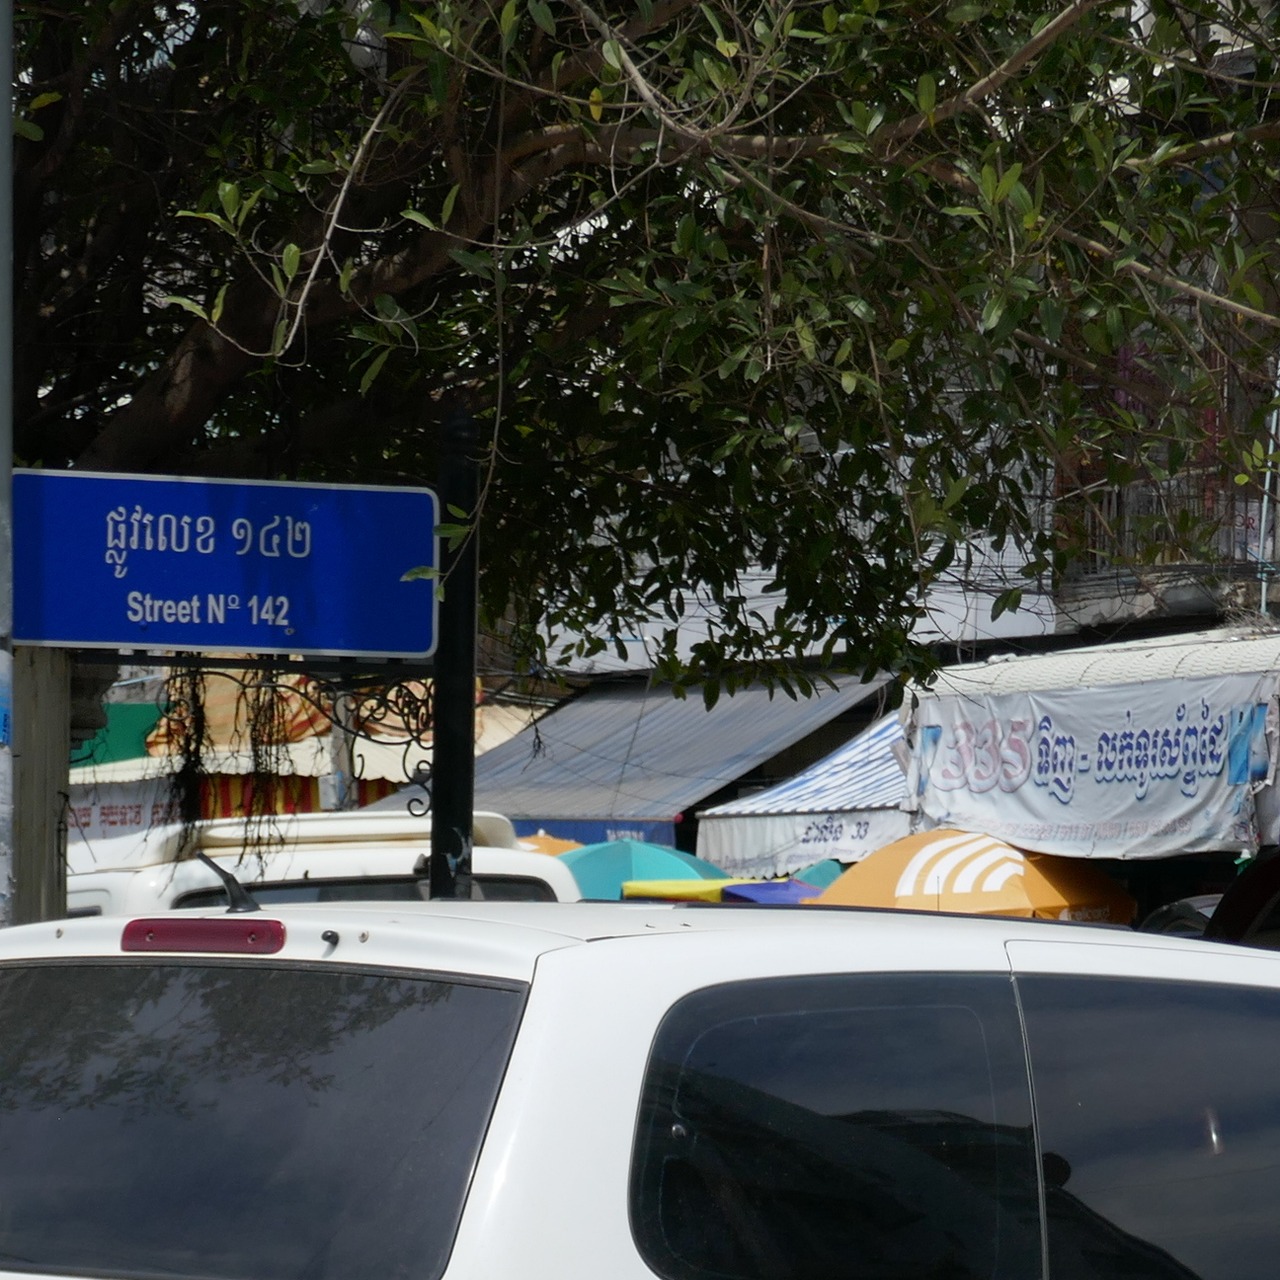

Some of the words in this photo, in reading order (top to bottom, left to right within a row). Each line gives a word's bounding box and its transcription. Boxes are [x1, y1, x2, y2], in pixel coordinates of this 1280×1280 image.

[104, 505, 215, 578] ផ្លូវលេខ
[231, 515, 311, 558] ១៤២
[126, 590, 201, 623] Street
[247, 595, 289, 626] 142
